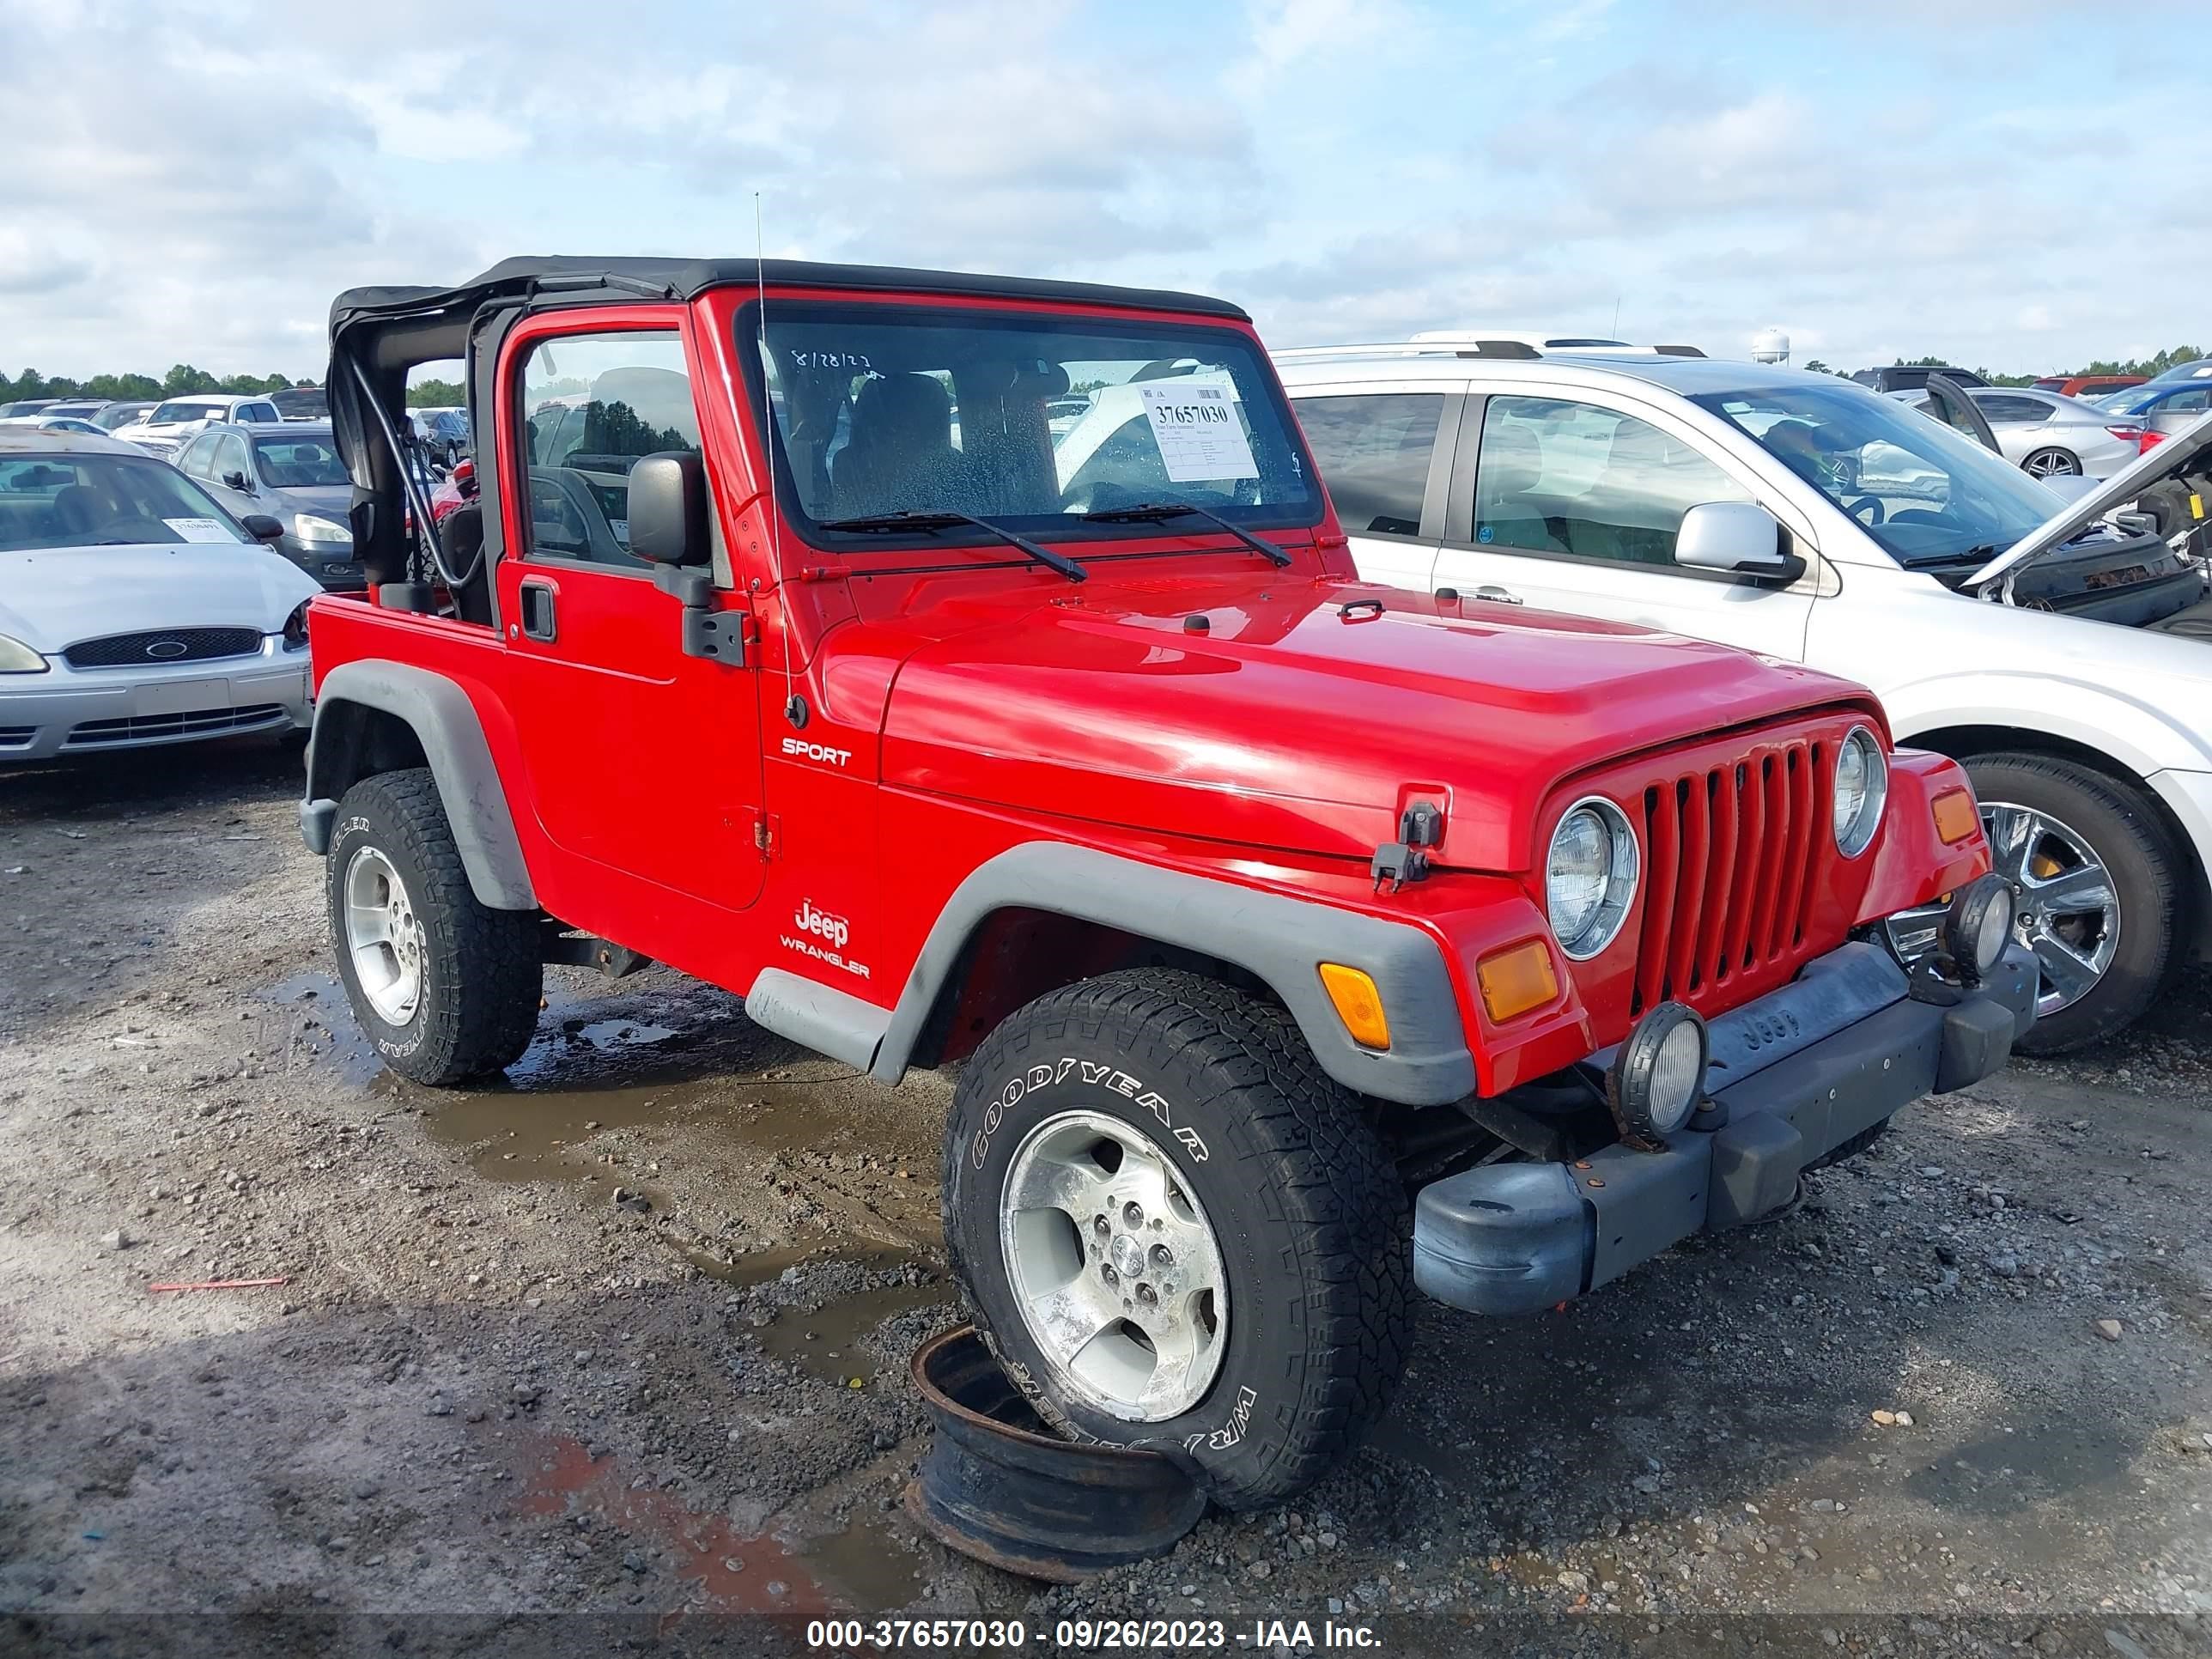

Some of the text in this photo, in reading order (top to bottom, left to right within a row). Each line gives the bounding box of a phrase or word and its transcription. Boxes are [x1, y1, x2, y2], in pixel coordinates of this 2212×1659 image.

[1155, 405, 1228, 424] 37657030
[781, 737, 852, 767] SPORT
[794, 896, 849, 949] Jeep
[780, 933, 871, 980] WRANGLER
[1743, 1009, 1800, 1052] Jeep
[972, 1058, 1210, 1170] GOODYEAR
